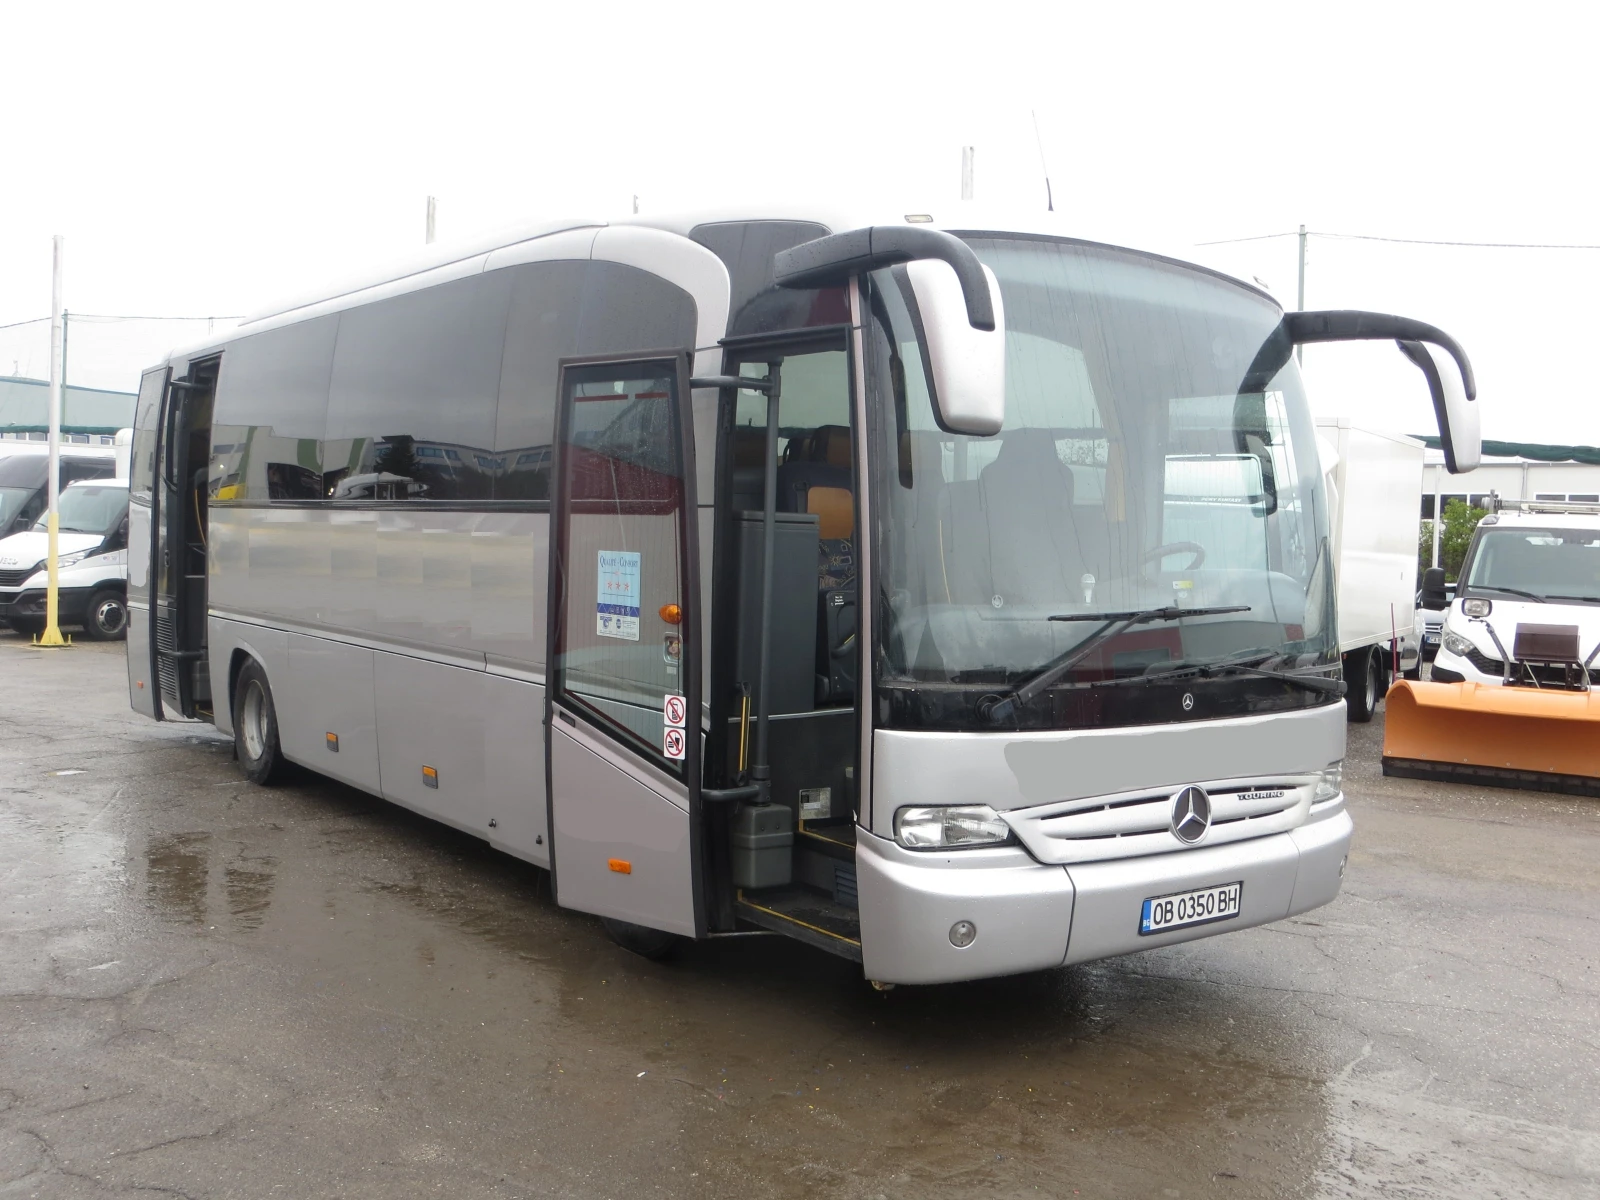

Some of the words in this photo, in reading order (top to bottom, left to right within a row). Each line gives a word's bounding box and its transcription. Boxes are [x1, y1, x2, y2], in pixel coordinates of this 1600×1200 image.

[1237, 791, 1284, 801] TOURINO
[1153, 900, 1174, 926] OB
[1178, 892, 1215, 921] 0350
[1217, 887, 1238, 913] BH
